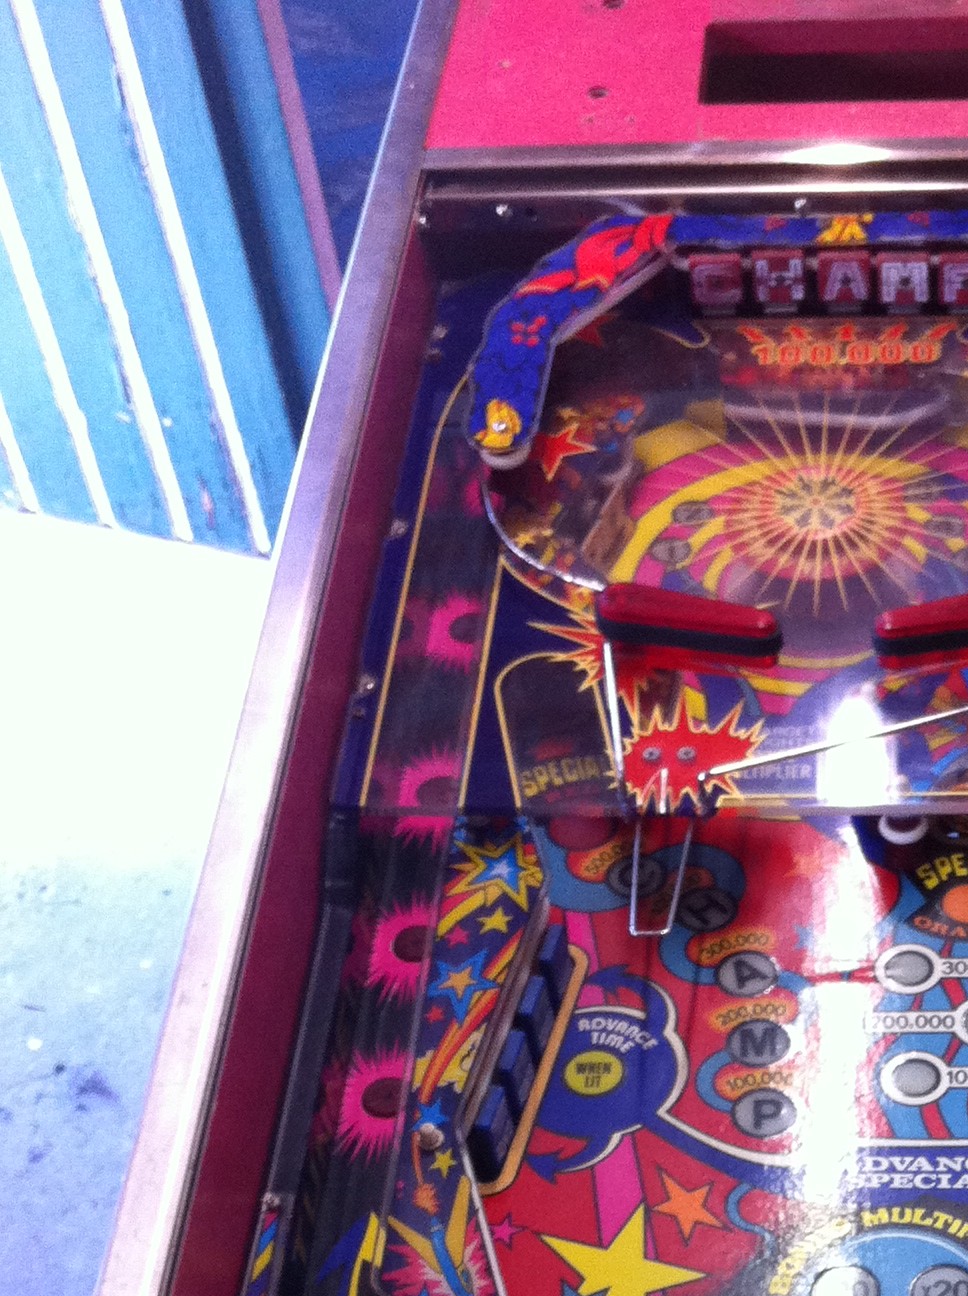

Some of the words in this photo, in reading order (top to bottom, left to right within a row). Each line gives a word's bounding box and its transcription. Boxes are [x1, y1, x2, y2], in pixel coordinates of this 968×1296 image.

[733, 958, 770, 989] A
[577, 1016, 659, 1051] ADVANCE
[590, 1032, 637, 1055] TIME
[739, 1027, 777, 1058] M
[752, 1100, 783, 1130] P
